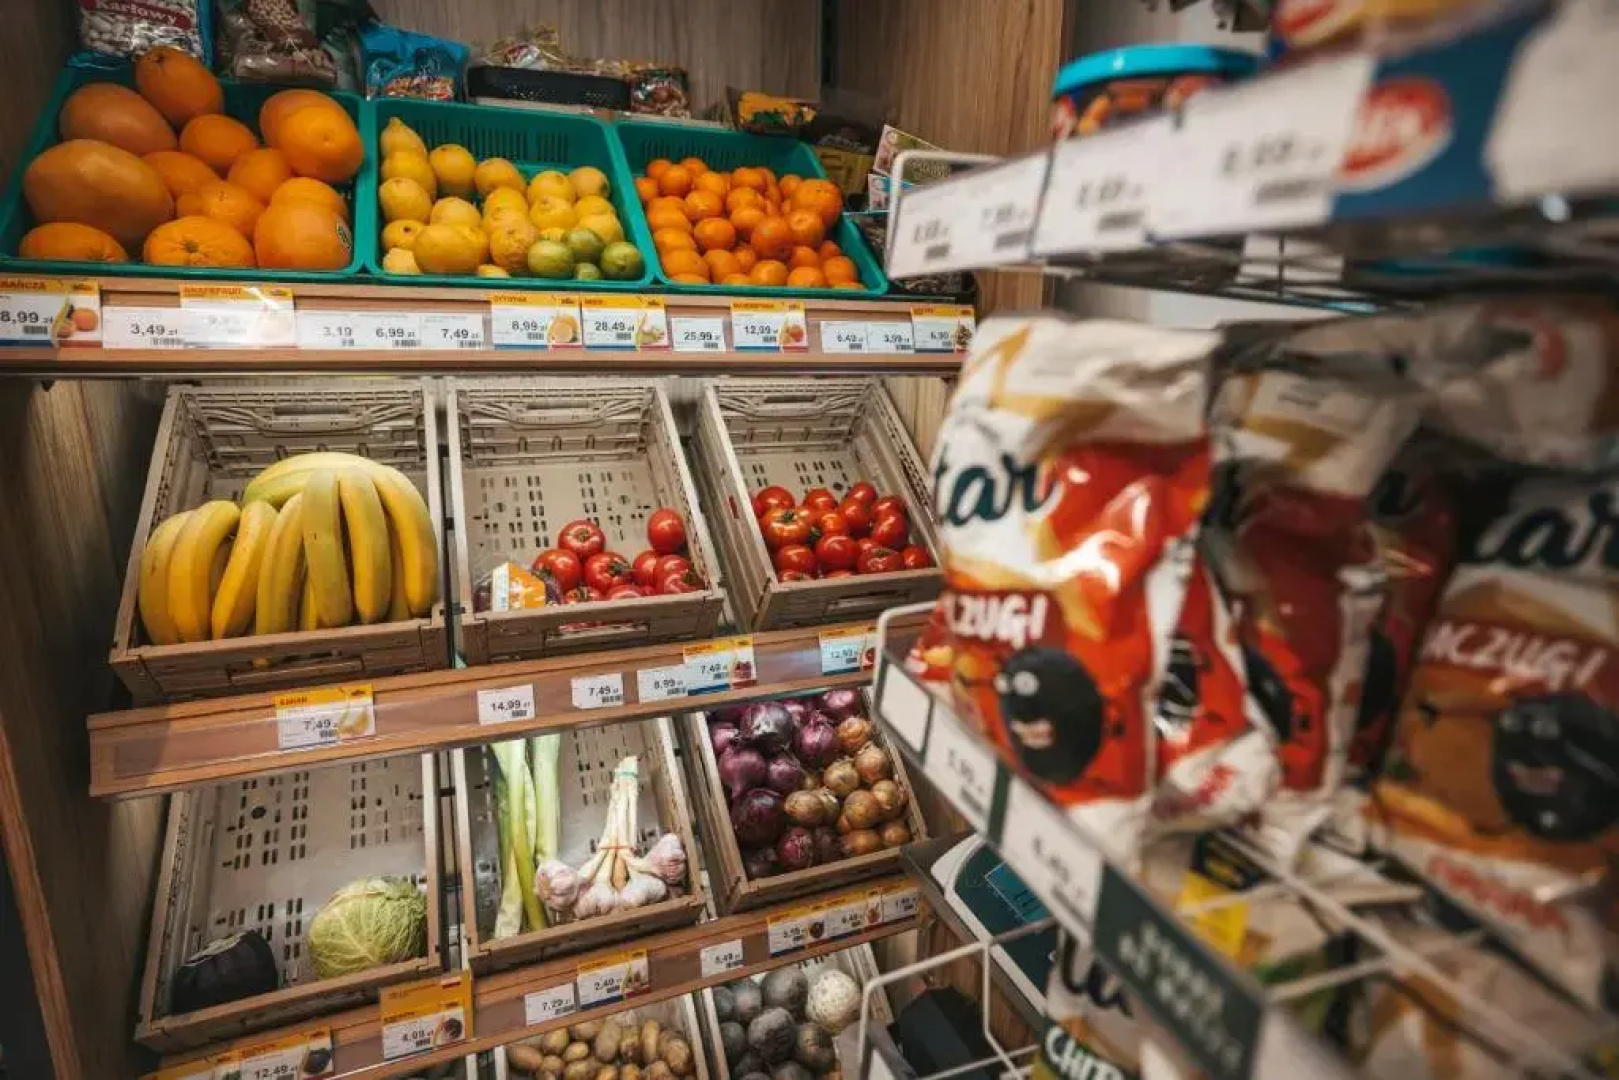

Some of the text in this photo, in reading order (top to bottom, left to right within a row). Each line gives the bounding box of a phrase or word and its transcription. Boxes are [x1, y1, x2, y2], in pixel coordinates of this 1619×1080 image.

[1, 310, 39, 324] 8,99
[131, 324, 165, 336] 3,49
[375, 328, 404, 339] 6,99
[441, 328, 469, 340] 7,49
